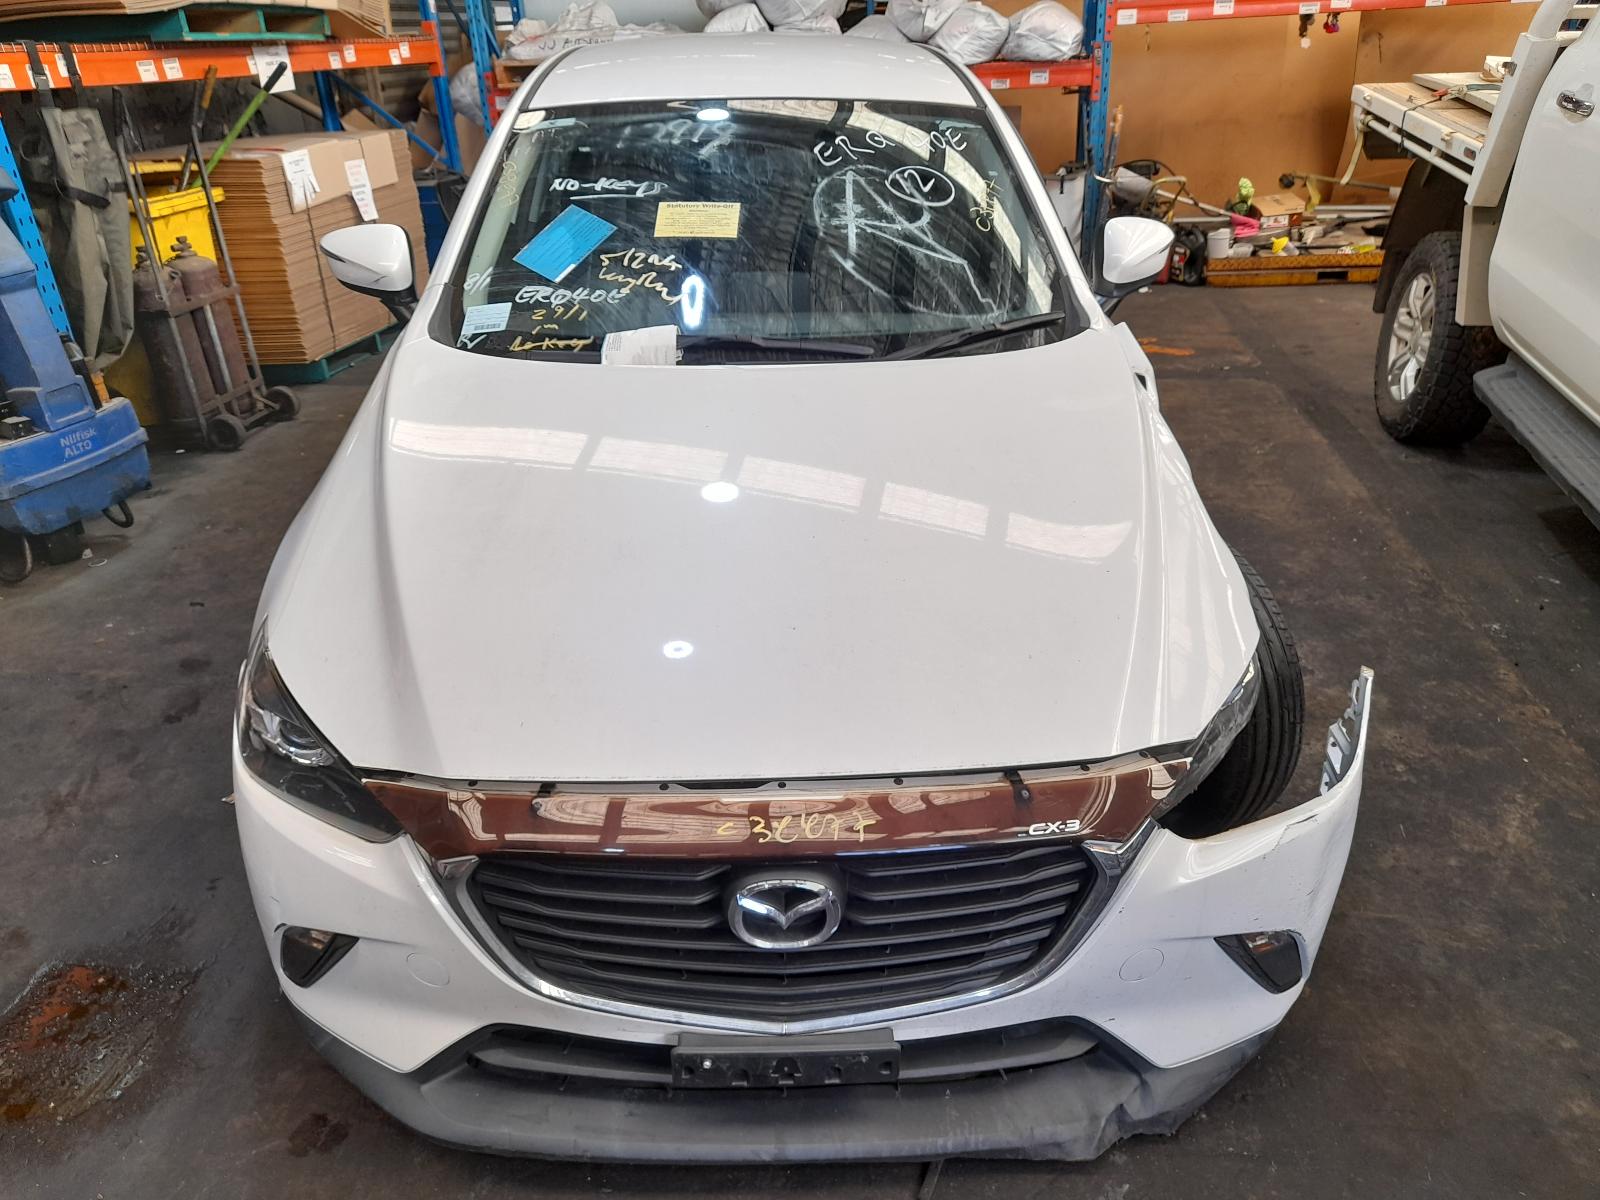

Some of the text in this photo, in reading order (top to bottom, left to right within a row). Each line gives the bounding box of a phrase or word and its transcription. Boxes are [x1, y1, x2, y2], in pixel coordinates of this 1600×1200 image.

[60, 427, 97, 447] Nilfisk
[65, 439, 92, 459] ALTO
[1028, 819, 1081, 836] CX-3
